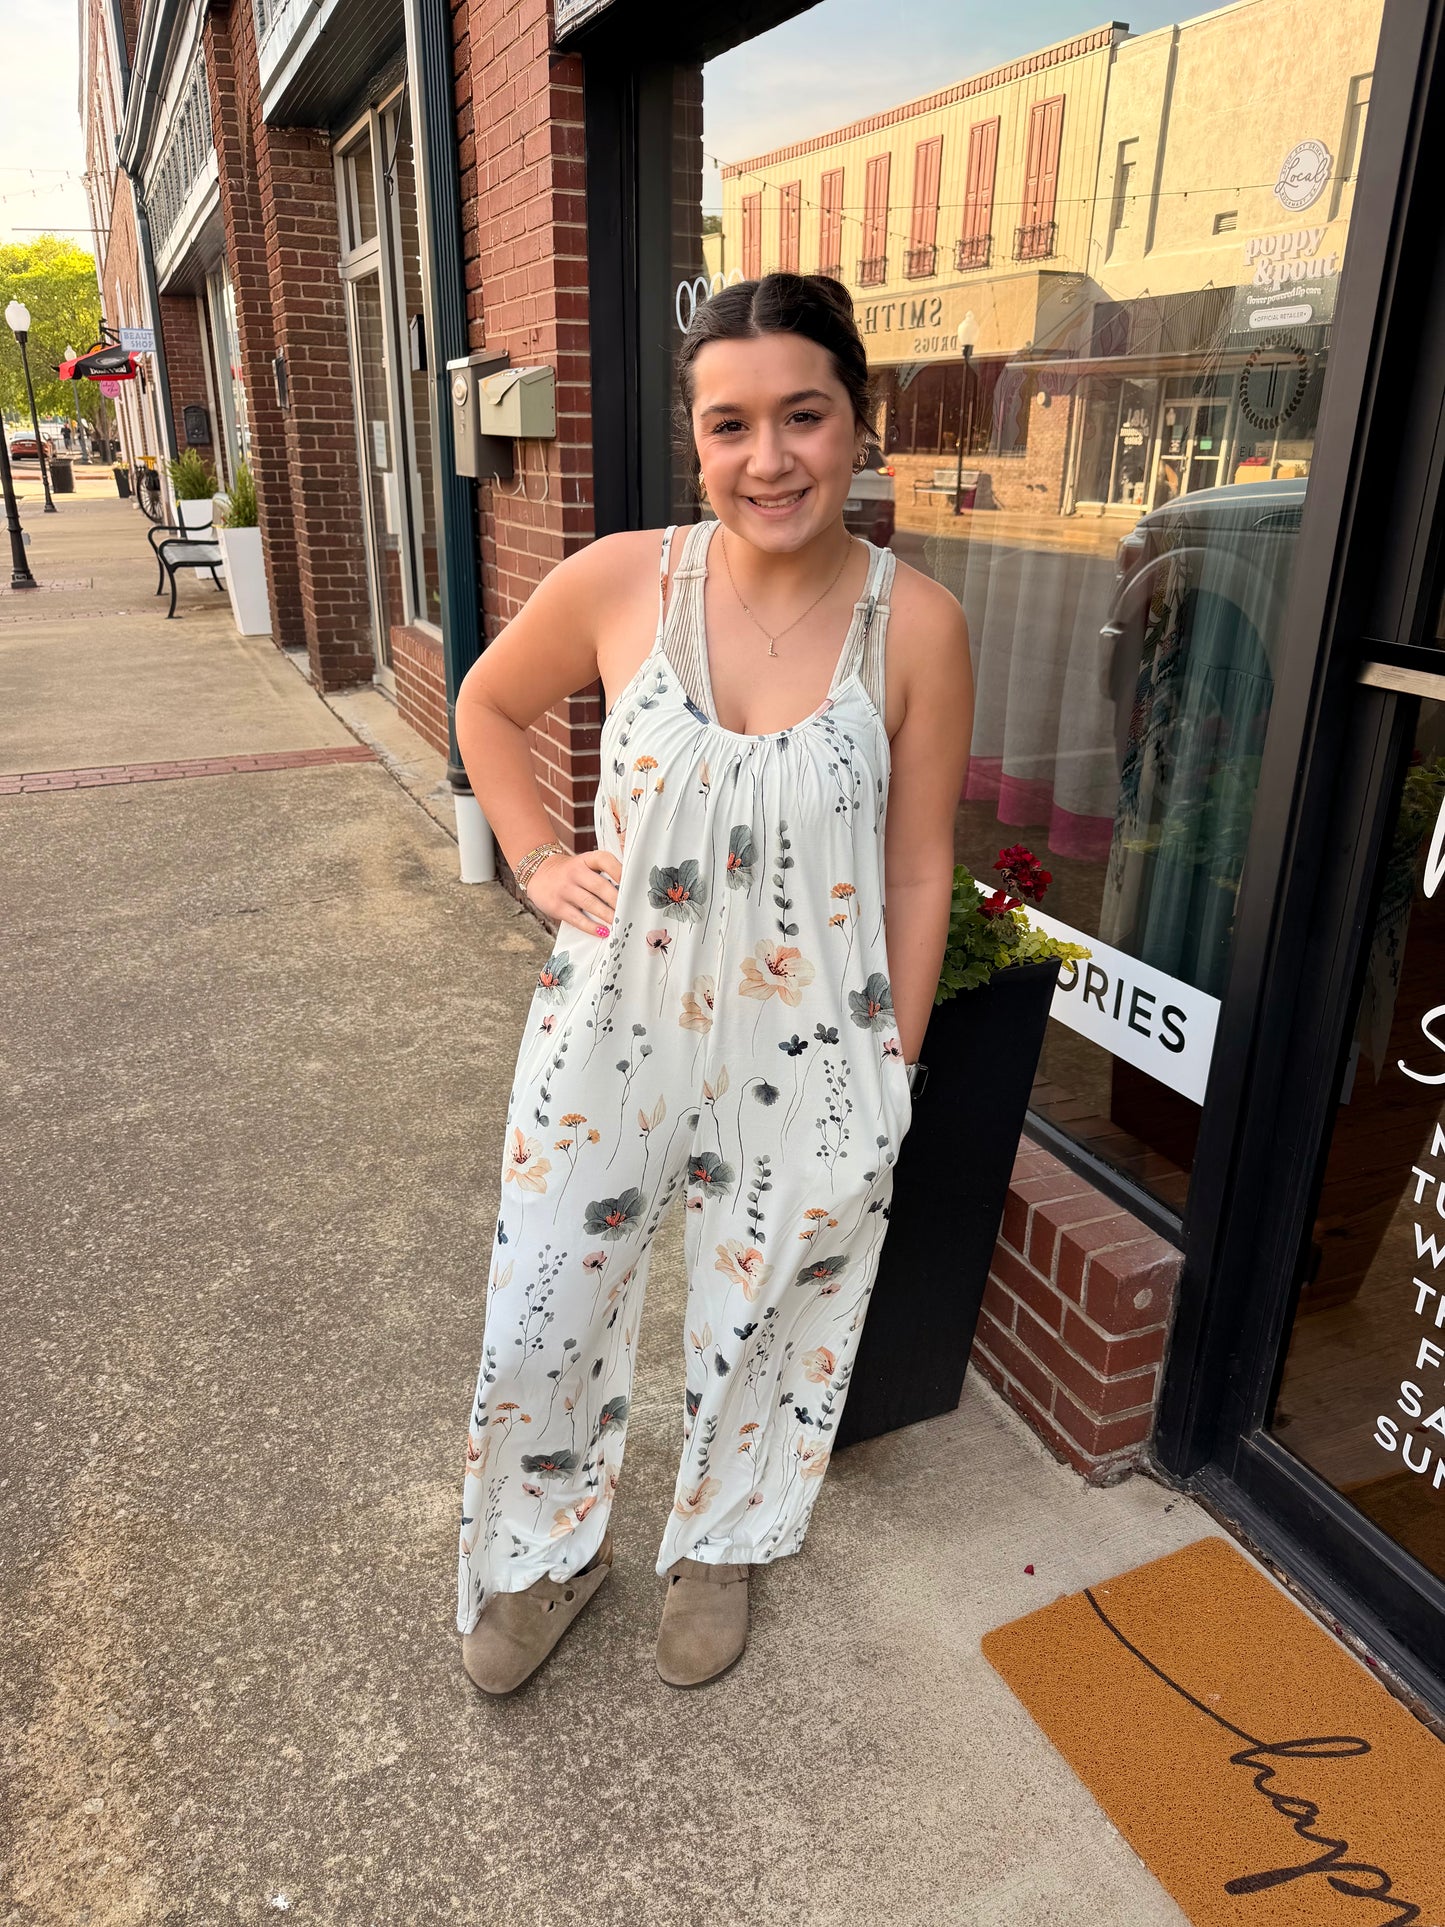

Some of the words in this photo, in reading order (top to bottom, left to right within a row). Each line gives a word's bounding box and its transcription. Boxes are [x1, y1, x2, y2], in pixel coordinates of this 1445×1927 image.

[1274, 157, 1328, 194] Local
[1243, 227, 1327, 266] poppy
[1256, 314, 1280, 322] OFFICIAL
